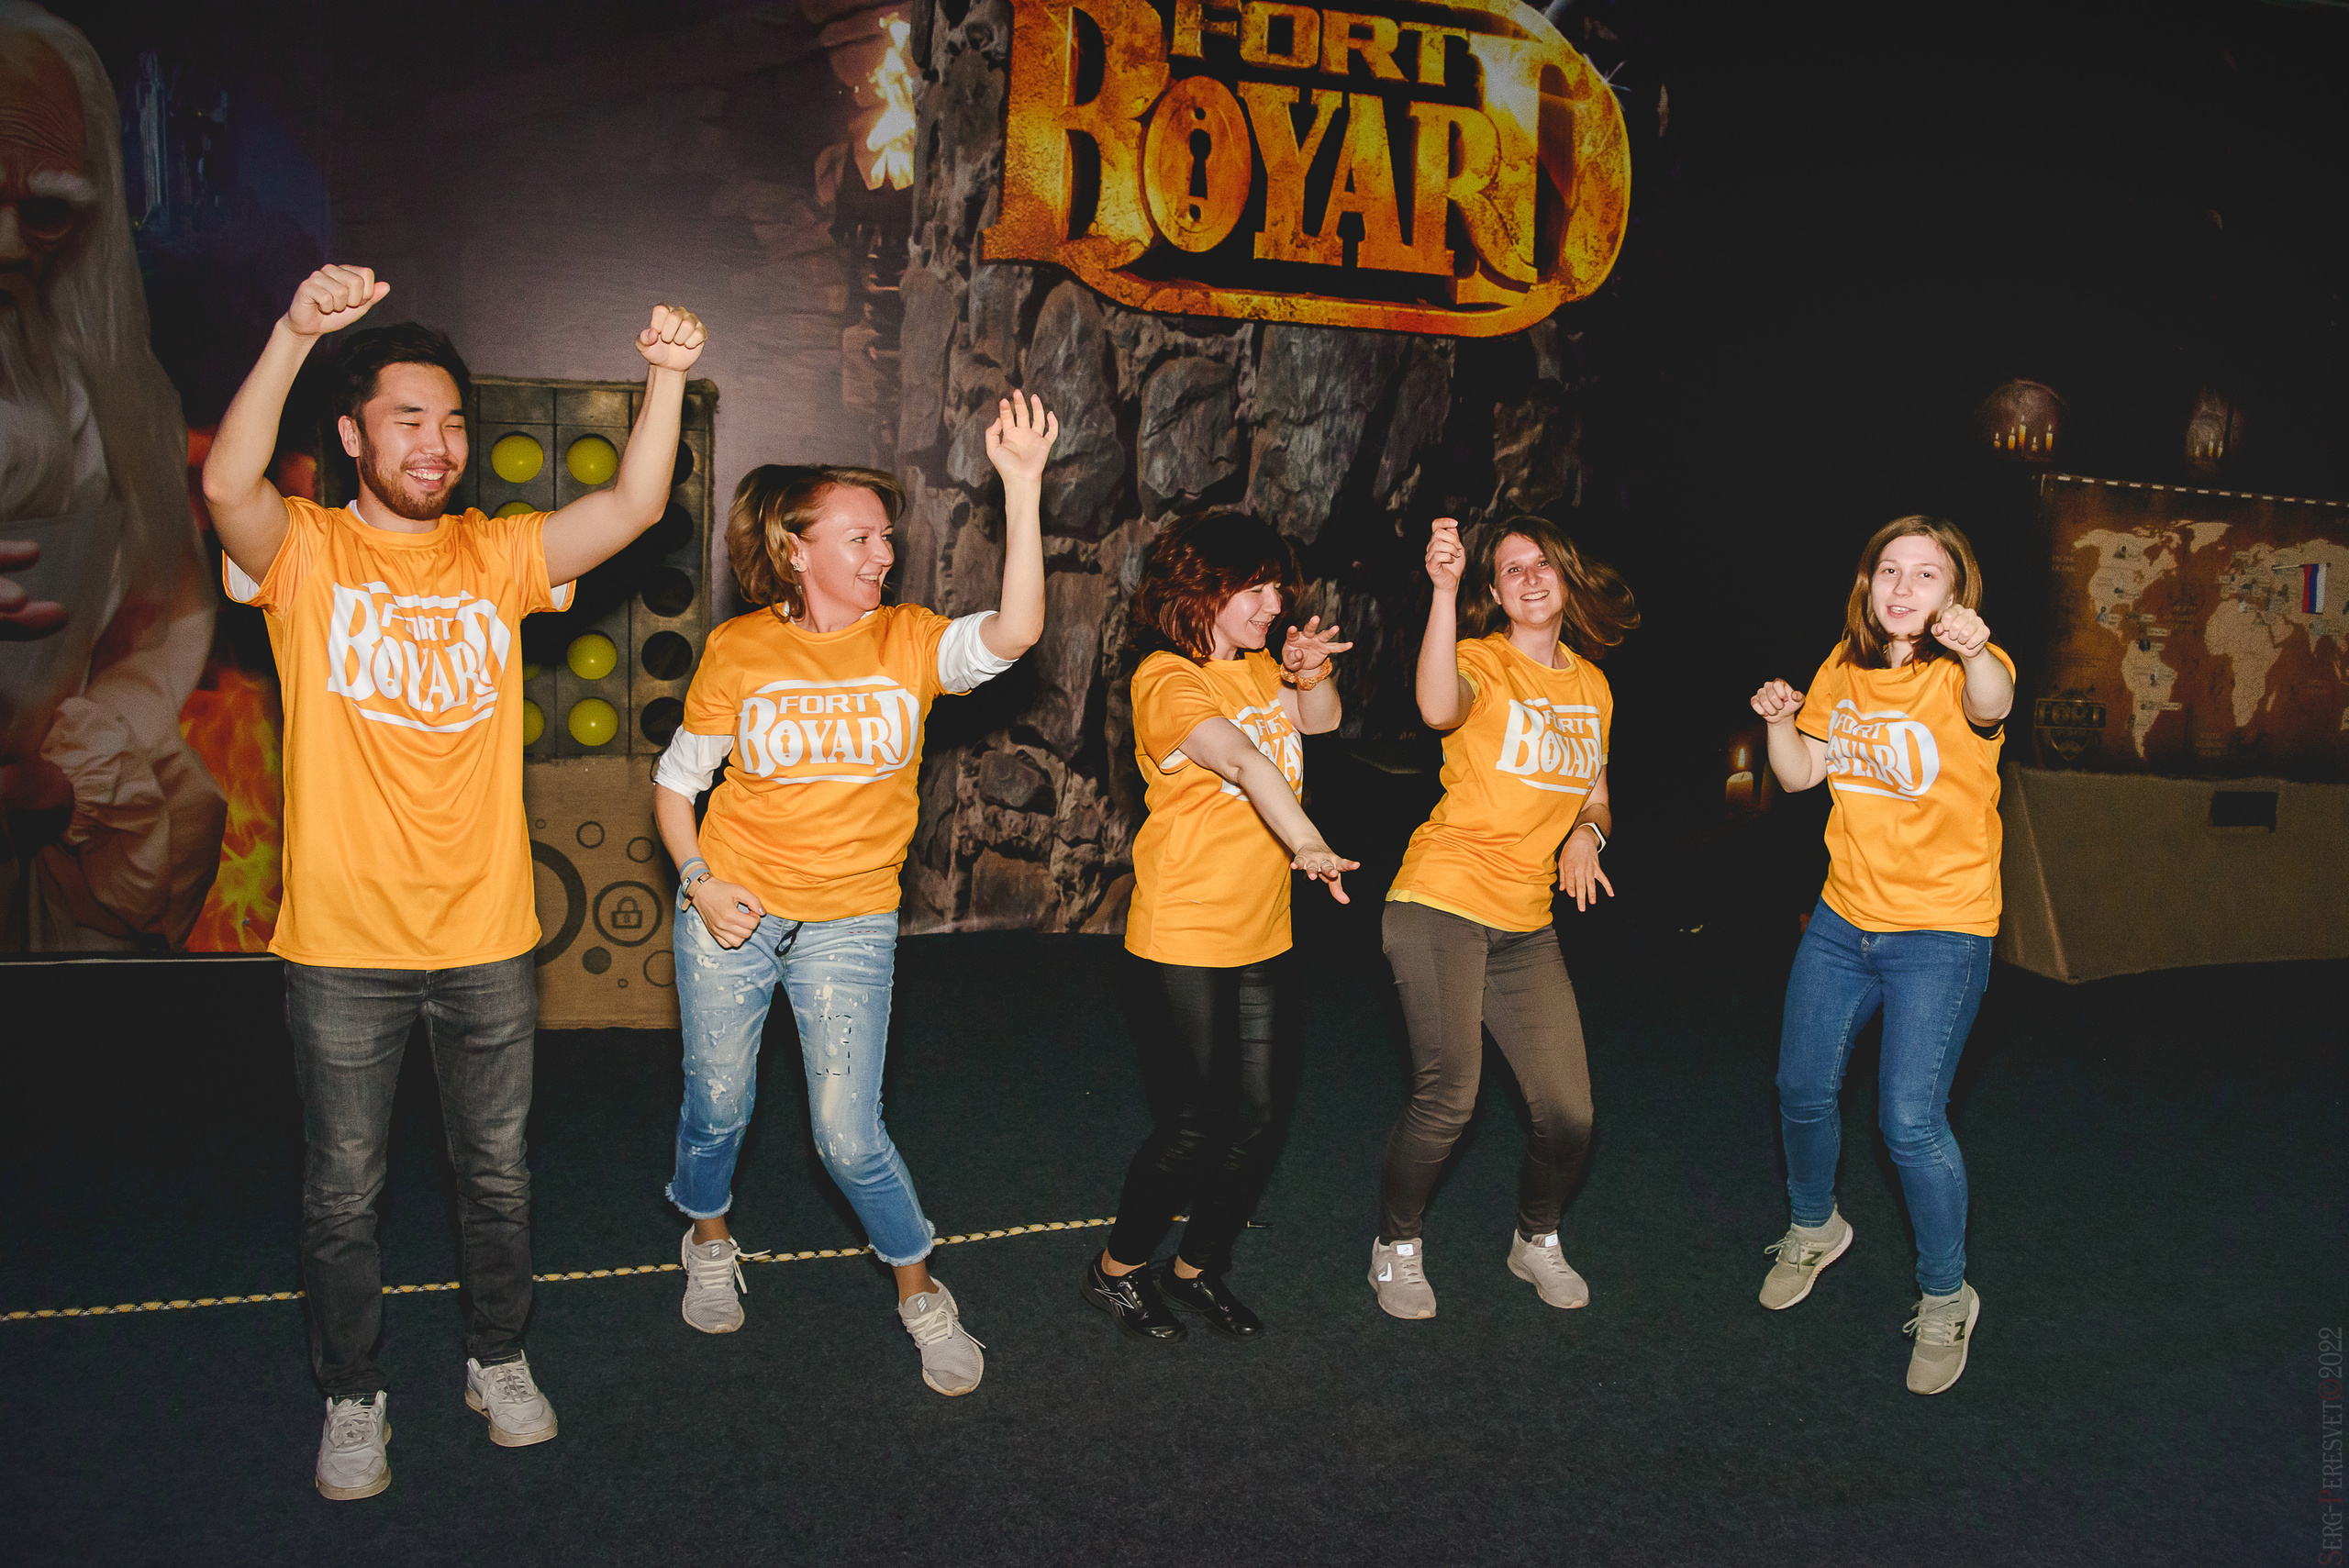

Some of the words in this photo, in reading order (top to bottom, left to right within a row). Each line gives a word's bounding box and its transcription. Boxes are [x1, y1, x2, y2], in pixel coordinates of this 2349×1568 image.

[1168, 0, 1470, 87] FORT
[982, 0, 1631, 305] BOYARD
[327, 582, 511, 713] BOYARD
[739, 688, 920, 778] BOYARD
[779, 693, 870, 715] FORT
[2038, 702, 2105, 727] FORT
